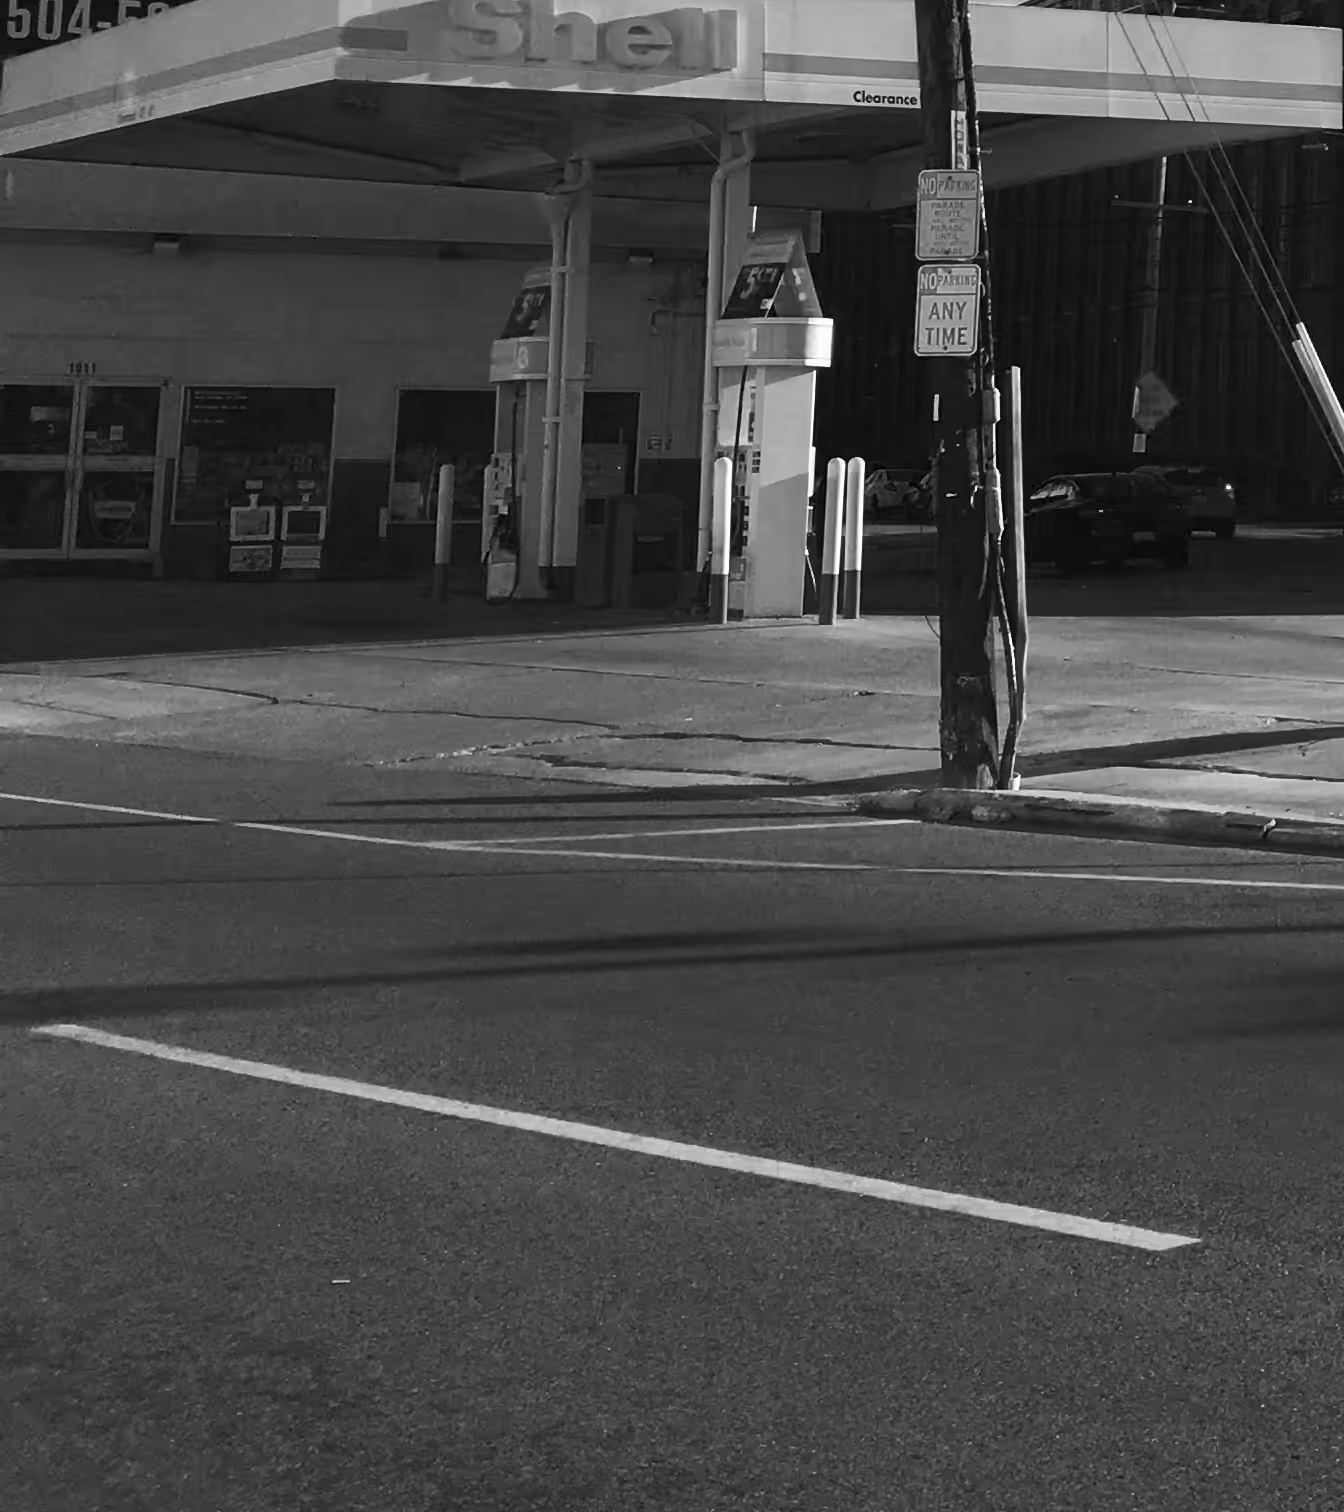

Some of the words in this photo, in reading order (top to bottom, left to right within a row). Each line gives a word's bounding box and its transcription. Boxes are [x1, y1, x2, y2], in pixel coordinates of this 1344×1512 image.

[852, 90, 918, 106] Clearance
[921, 176, 937, 195] NO
[938, 179, 977, 193] PARKING
[920, 273, 937, 290] NO
[938, 274, 977, 287] PARKING
[928, 301, 968, 321] ANY
[924, 327, 969, 346] TIME
